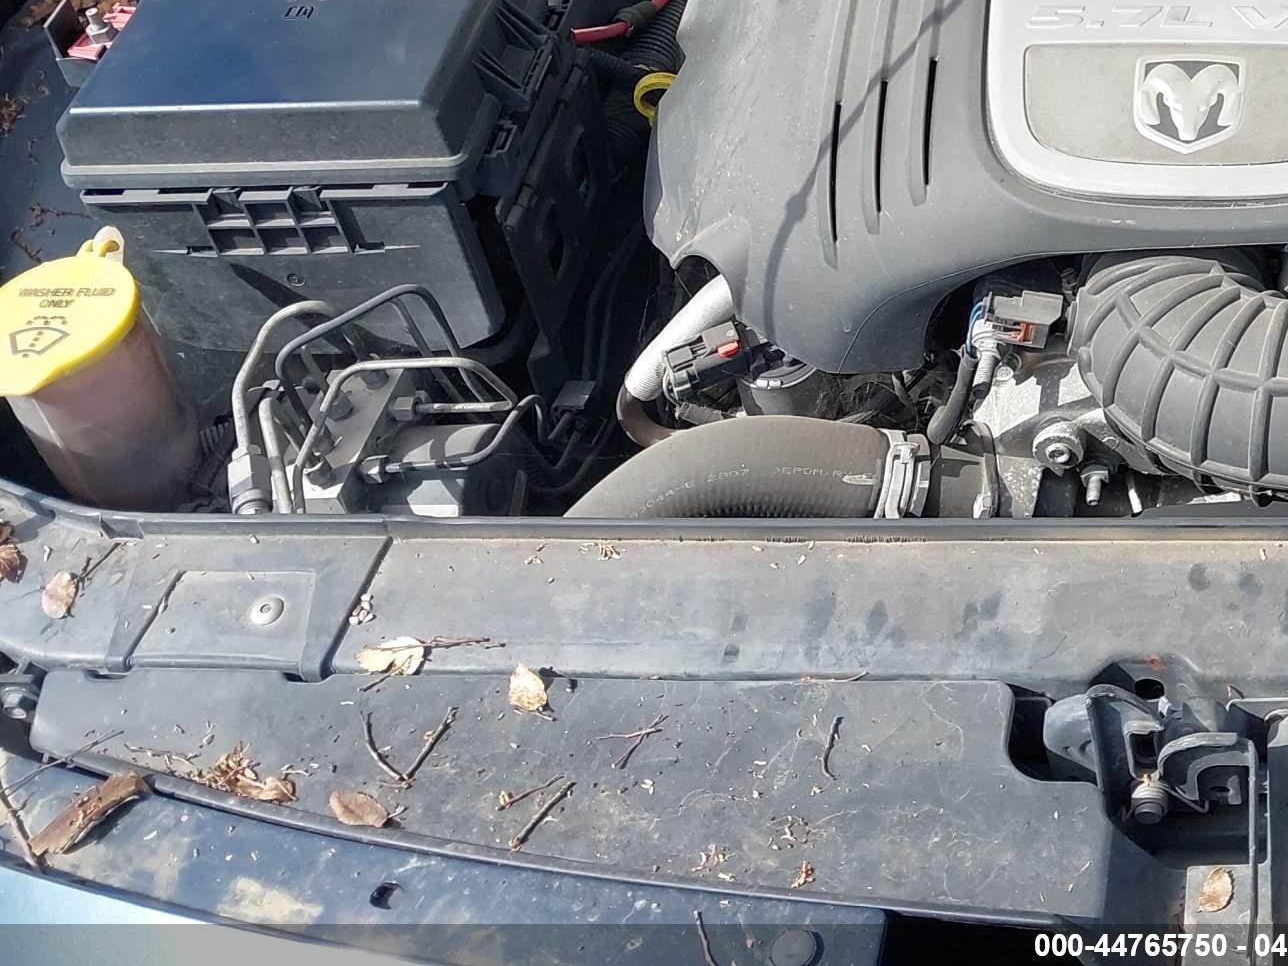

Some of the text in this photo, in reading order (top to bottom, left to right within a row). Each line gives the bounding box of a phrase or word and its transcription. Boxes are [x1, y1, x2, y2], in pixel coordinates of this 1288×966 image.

[1025, 5, 1214, 29] 5.7L
[19, 288, 116, 297] WASHER FLUID
[39, 299, 75, 308] ONLY
